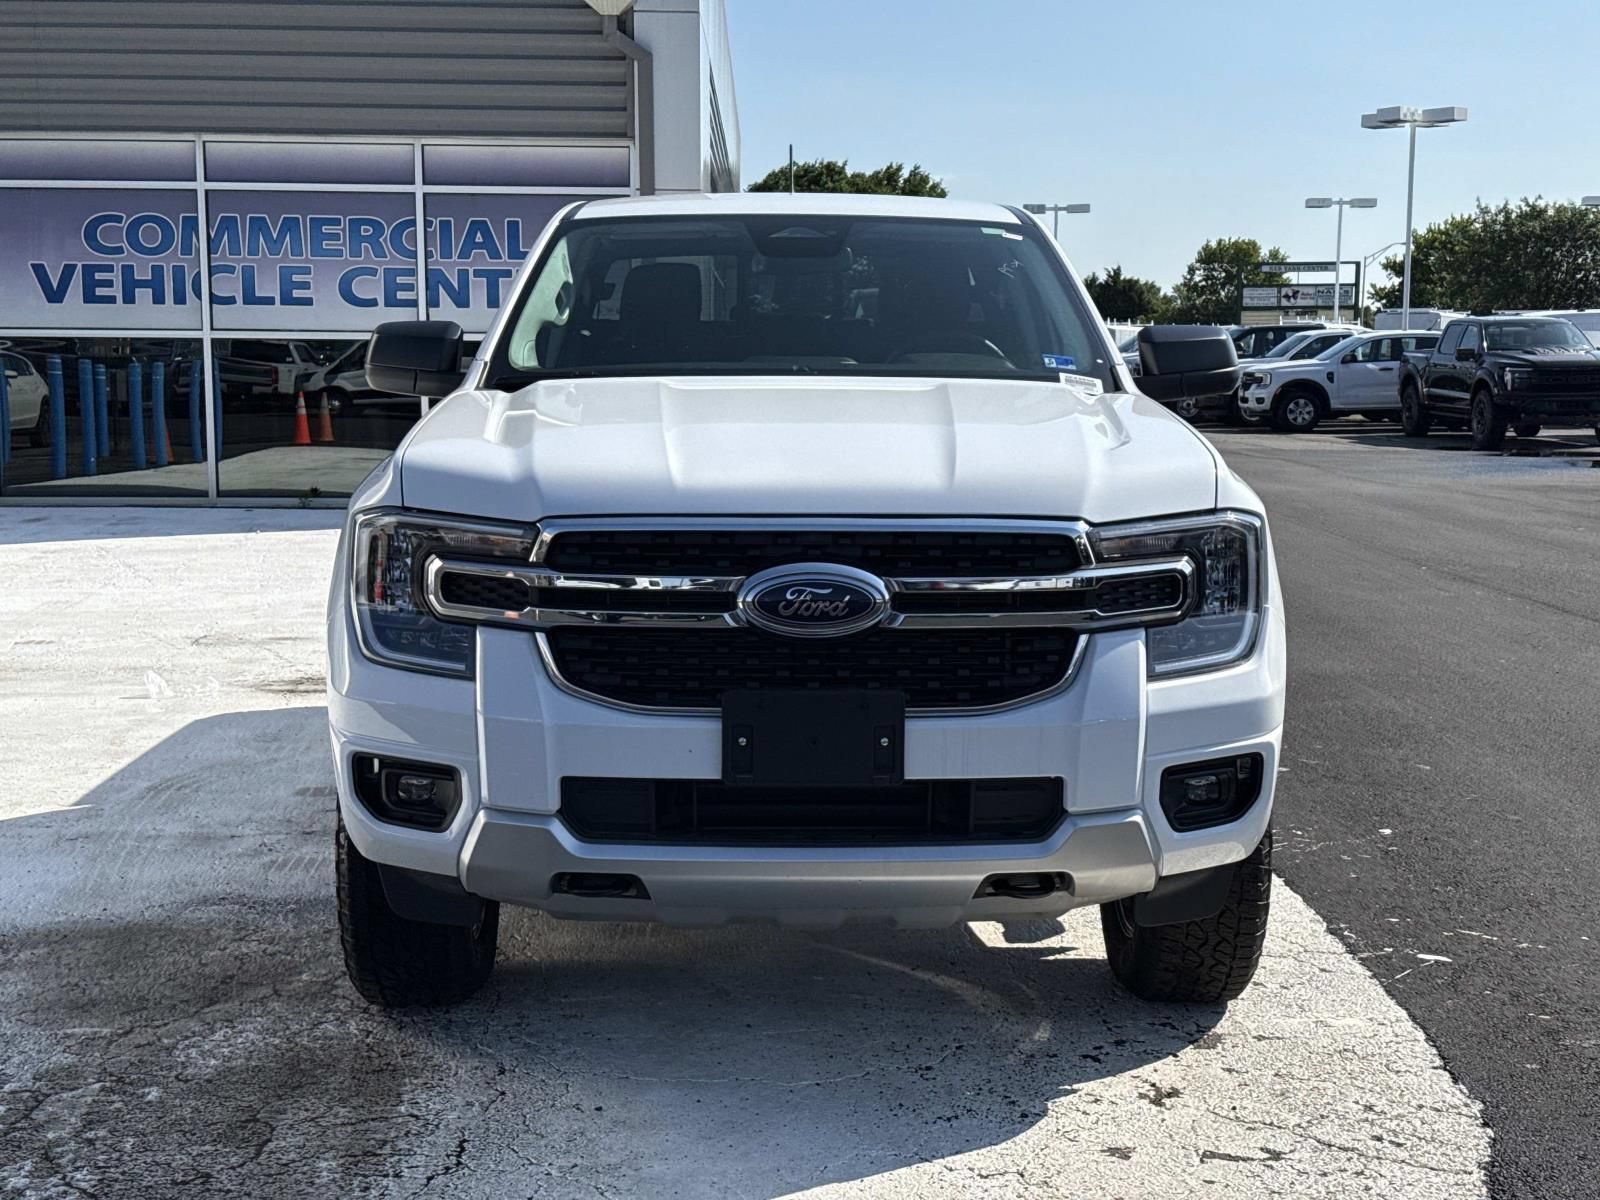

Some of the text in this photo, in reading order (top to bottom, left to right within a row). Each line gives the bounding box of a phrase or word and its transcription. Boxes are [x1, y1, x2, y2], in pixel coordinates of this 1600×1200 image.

[82, 212, 530, 262] COMMERCIAL
[28, 261, 519, 309] VEHICLE CENT
[778, 586, 850, 616] Ford
